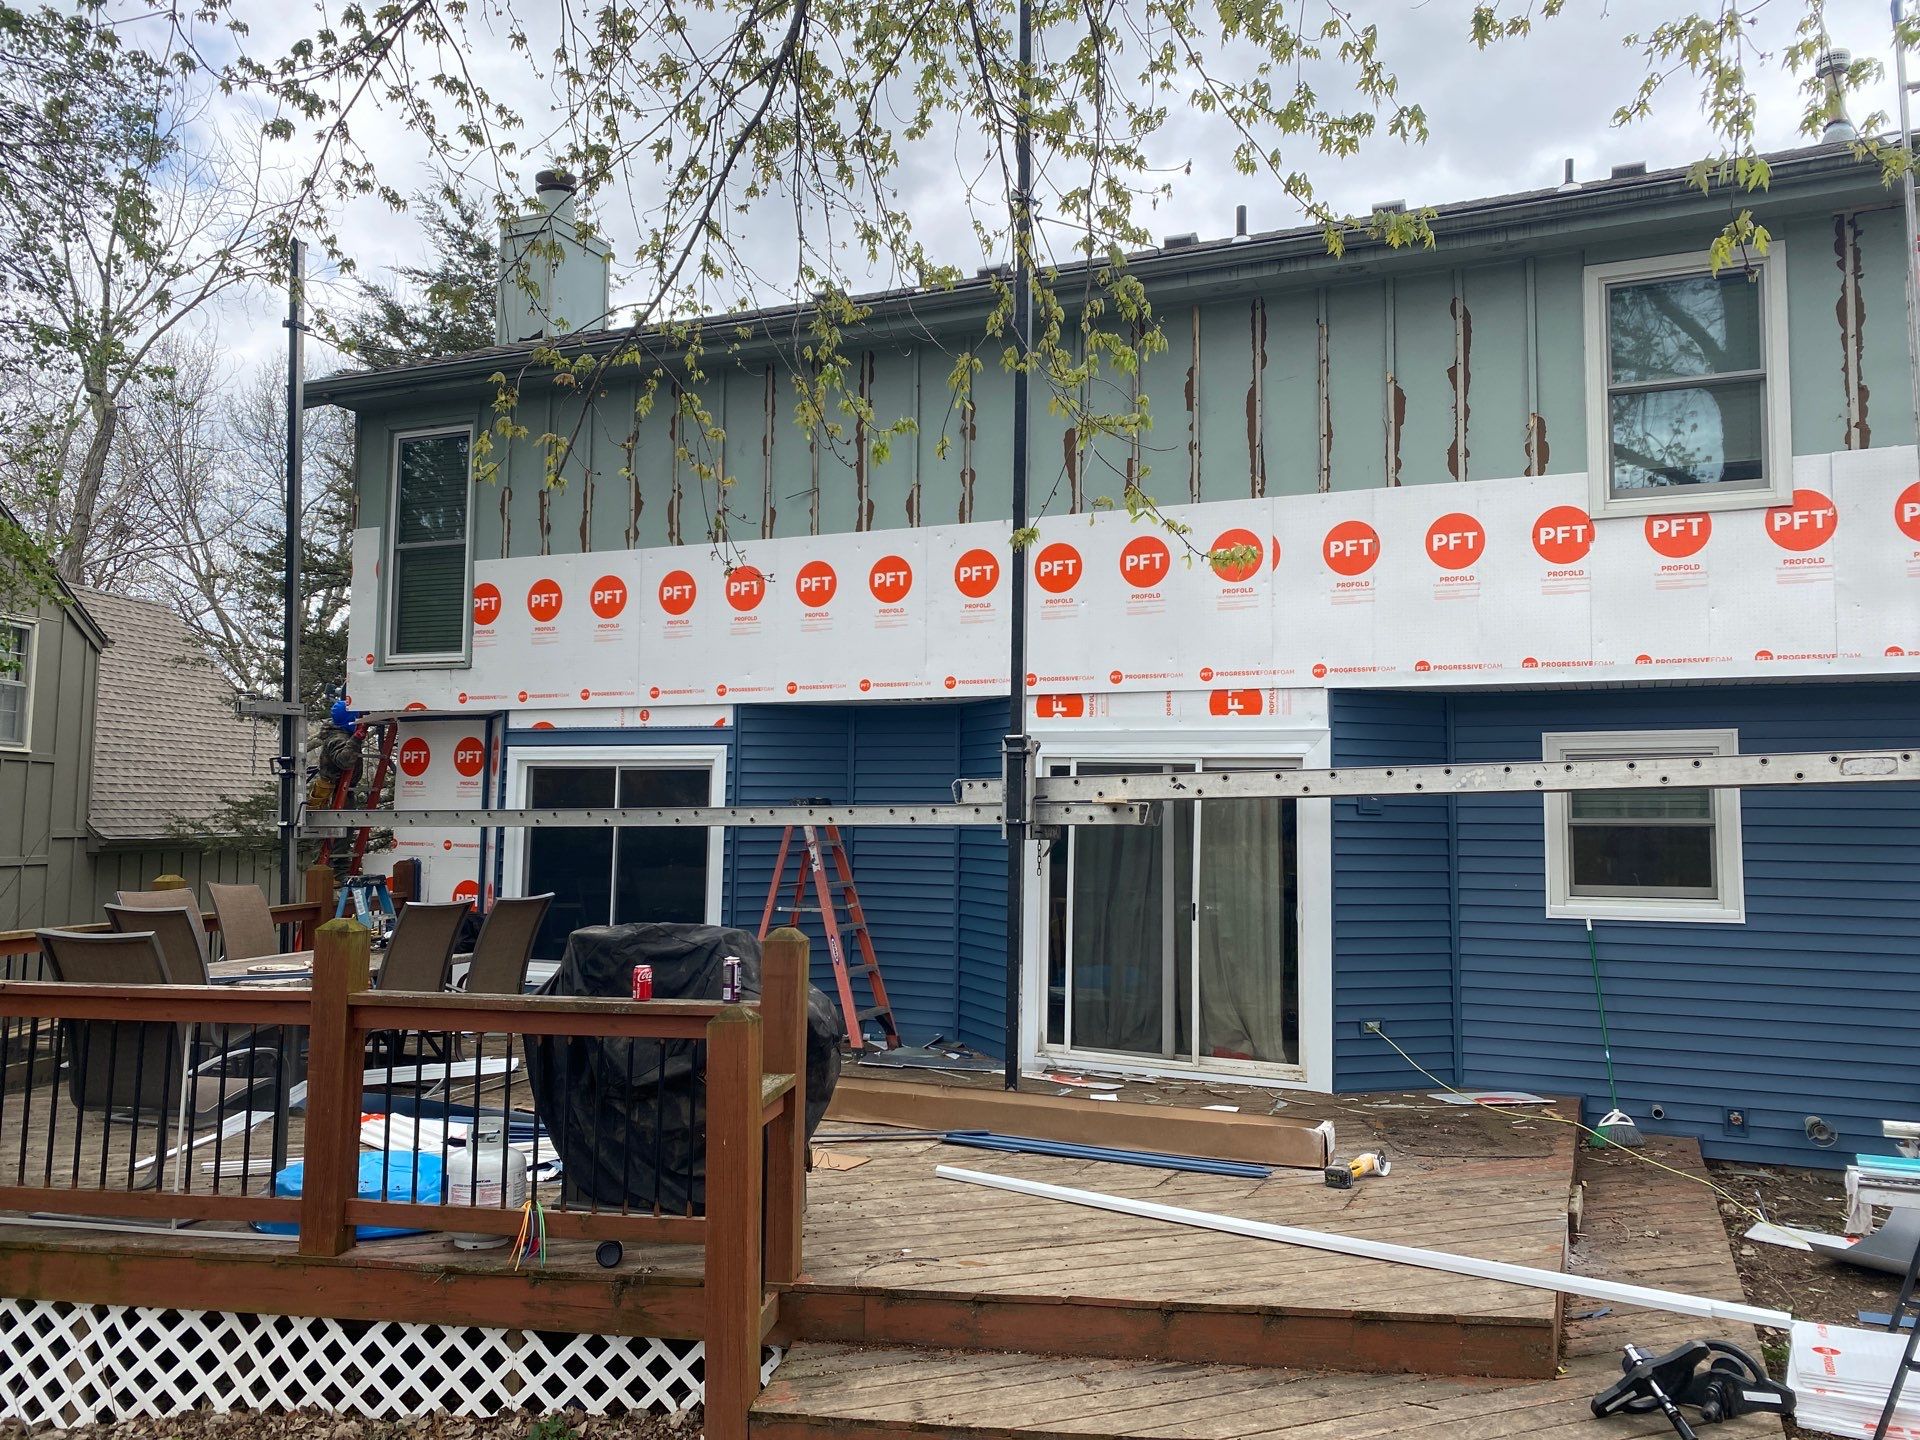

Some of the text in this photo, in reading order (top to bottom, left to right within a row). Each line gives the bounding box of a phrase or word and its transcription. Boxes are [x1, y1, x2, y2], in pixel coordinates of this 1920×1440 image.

[1652, 518, 1703, 538] PFT
[1773, 509, 1826, 532] PFT
[1432, 532, 1478, 551] PFT
[1539, 524, 1587, 545] PFT
[1329, 538, 1374, 558] PFT
[1040, 559, 1076, 577] PFT
[1126, 552, 1164, 571] PFT
[1783, 557, 1825, 565] PROFOLD
[874, 571, 907, 588] PFT
[960, 565, 994, 582] PFT
[663, 584, 692, 600] PFT
[730, 580, 760, 596] PFT
[800, 576, 832, 592] PFT
[474, 597, 498, 610] PFT
[532, 592, 559, 608] PFT
[594, 590, 623, 604] PFT
[1329, 666, 1396, 674] PROGRESSIVEFOAM
[1541, 660, 1614, 668] PROGRESSIVEFOAM
[402, 751, 427, 763] PFT
[457, 751, 482, 763] PFT
